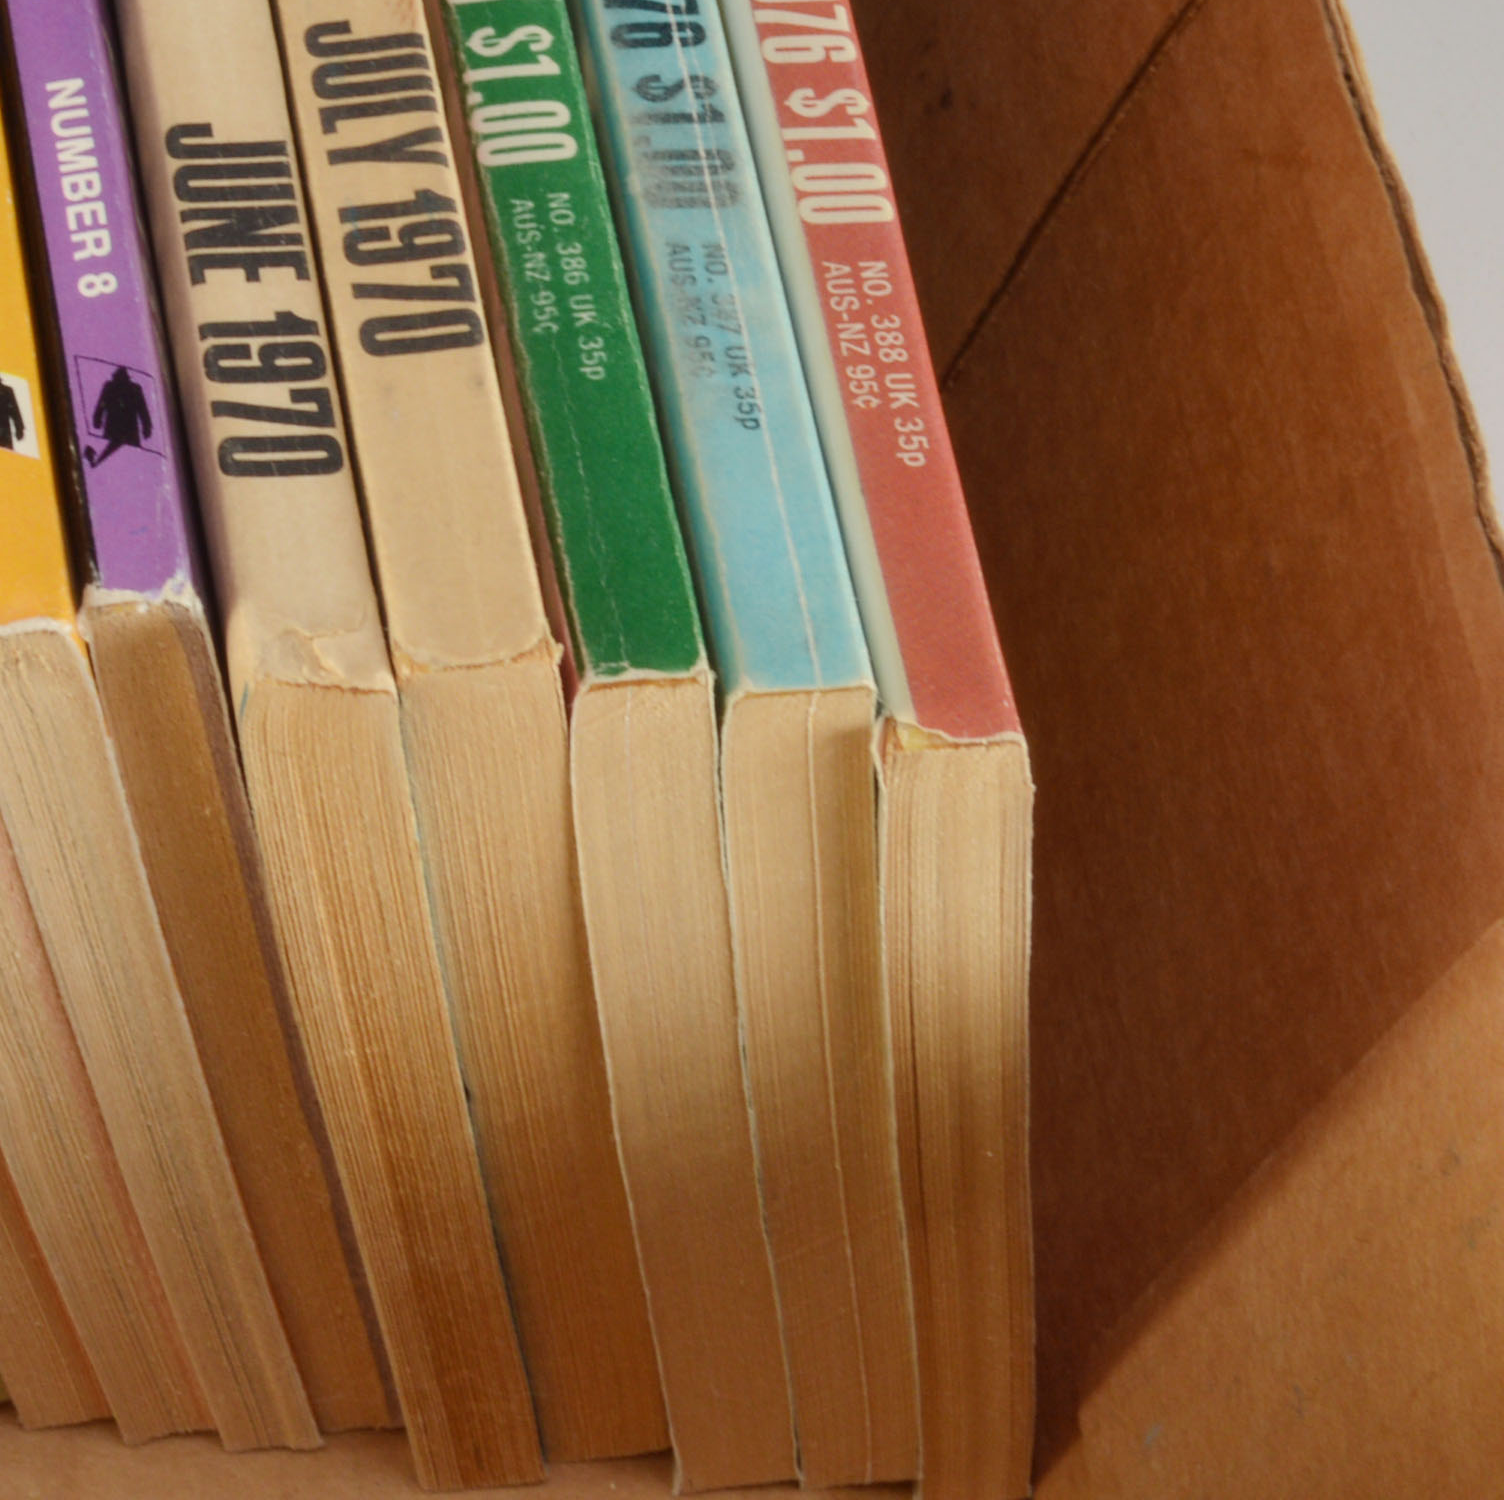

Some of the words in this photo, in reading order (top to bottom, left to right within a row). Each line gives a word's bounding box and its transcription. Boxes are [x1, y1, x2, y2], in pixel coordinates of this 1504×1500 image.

[305, 21, 444, 164] JULY
[464, 25, 576, 165] $1.00
[46, 78, 110, 259] NUMBER
[770, 88, 896, 224] $1.00
[165, 123, 308, 283] JUNE
[547, 191, 575, 225] NO.
[340, 190, 481, 355] 1970
[510, 198, 551, 281] AUS-NZ
[555, 241, 589, 285] 386
[77, 271, 117, 297] 8
[569, 293, 598, 326] UK
[822, 261, 870, 356] AUS-NZ
[858, 260, 892, 304] NO.
[577, 335, 607, 380] 35p
[871, 314, 908, 362] 388
[199, 312, 342, 477] 1970
[884, 372, 919, 408] UK
[893, 416, 929, 467] 35p
